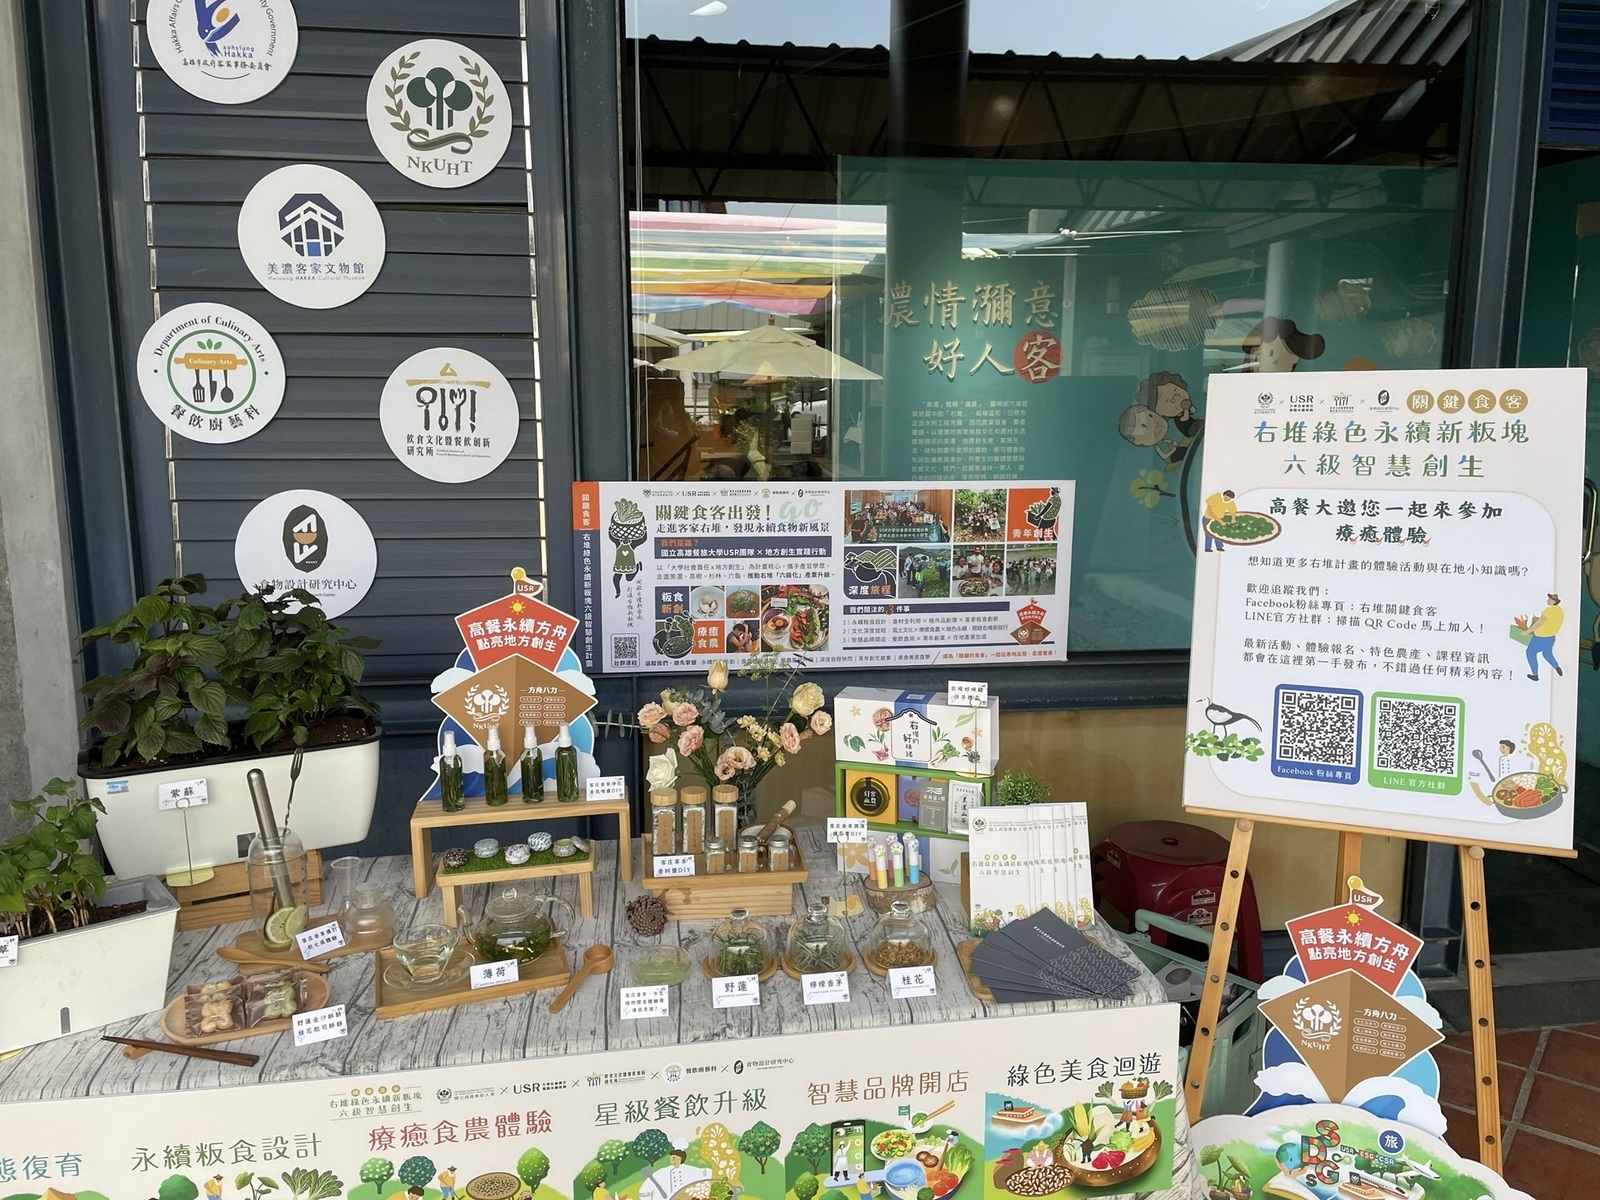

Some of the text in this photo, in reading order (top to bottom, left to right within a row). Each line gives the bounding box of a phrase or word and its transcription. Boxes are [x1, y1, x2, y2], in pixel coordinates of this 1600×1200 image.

[168, 3, 184, 54] Hakka Affairs
[265, 8, 278, 57] Government
[224, 51, 253, 59] Hakka
[182, 57, 273, 71] 高雄市政府客家事務委員會
[407, 155, 474, 176] NKUHT
[267, 262, 365, 275] 美濃客家文物館
[153, 315, 267, 364] Department of Culinary Arts
[188, 357, 234, 366] Culinary Arts
[923, 334, 1063, 383] 好人客
[1290, 394, 1314, 404] USR
[1411, 393, 1524, 410] 關鍵食客
[169, 404, 262, 432] 餐飲廚藝科
[1253, 419, 1530, 445] 右堆綠色永續新粄塊
[406, 434, 491, 449] 飲食文化暨餐飲創新
[406, 446, 435, 457] 研究所
[1283, 453, 1485, 479] 六級智慧創生
[581, 493, 591, 527] 關鍵食客
[656, 504, 771, 521] 關鍵食客出發！
[1268, 496, 1503, 519] 高餐大邀您一起來參加
[1012, 528, 1054, 539] 青年創生
[1336, 524, 1428, 544] 療癒體驗
[517, 584, 535, 592] USR
[848, 585, 891, 596] 深度旅程
[661, 603, 684, 614] 新創
[467, 617, 568, 641] 高餐永續方舟
[697, 626, 719, 637] 療癒
[1364, 618, 1383, 630] QR
[1386, 619, 1417, 631] Code
[477, 635, 557, 653] 點亮地方創生
[697, 638, 719, 649] 食農
[528, 686, 558, 695] 方舟八力
[1277, 765, 1353, 781] Facebook 粉絲專頁
[1383, 776, 1447, 791] LINE 官方社群
[170, 786, 195, 798] 紫蘇
[1353, 894, 1373, 904] USR
[1298, 928, 1410, 962] 高餐永續方舟
[1307, 946, 1398, 974] 點亮地方創生
[484, 967, 509, 981] 薄荷
[901, 974, 925, 986] 桂花
[724, 981, 748, 993] 野蓮
[809, 978, 843, 989] 檸檬香茅
[1363, 1008, 1398, 1021] 方舟八力
[1301, 1039, 1332, 1051] NKUHT
[1007, 1052, 1162, 1087] 綠色美食迴遊
[513, 1083, 541, 1095] USR
[806, 1068, 970, 1106] 智慧品牌開店
[594, 1087, 768, 1127] 星級餐飲升級
[368, 1109, 553, 1152] 療癒食農體驗
[1384, 1134, 1398, 1149] 旅
[131, 1132, 322, 1172] 永續粄食設計
[1341, 1146, 1395, 1165] USR ESG CSR
